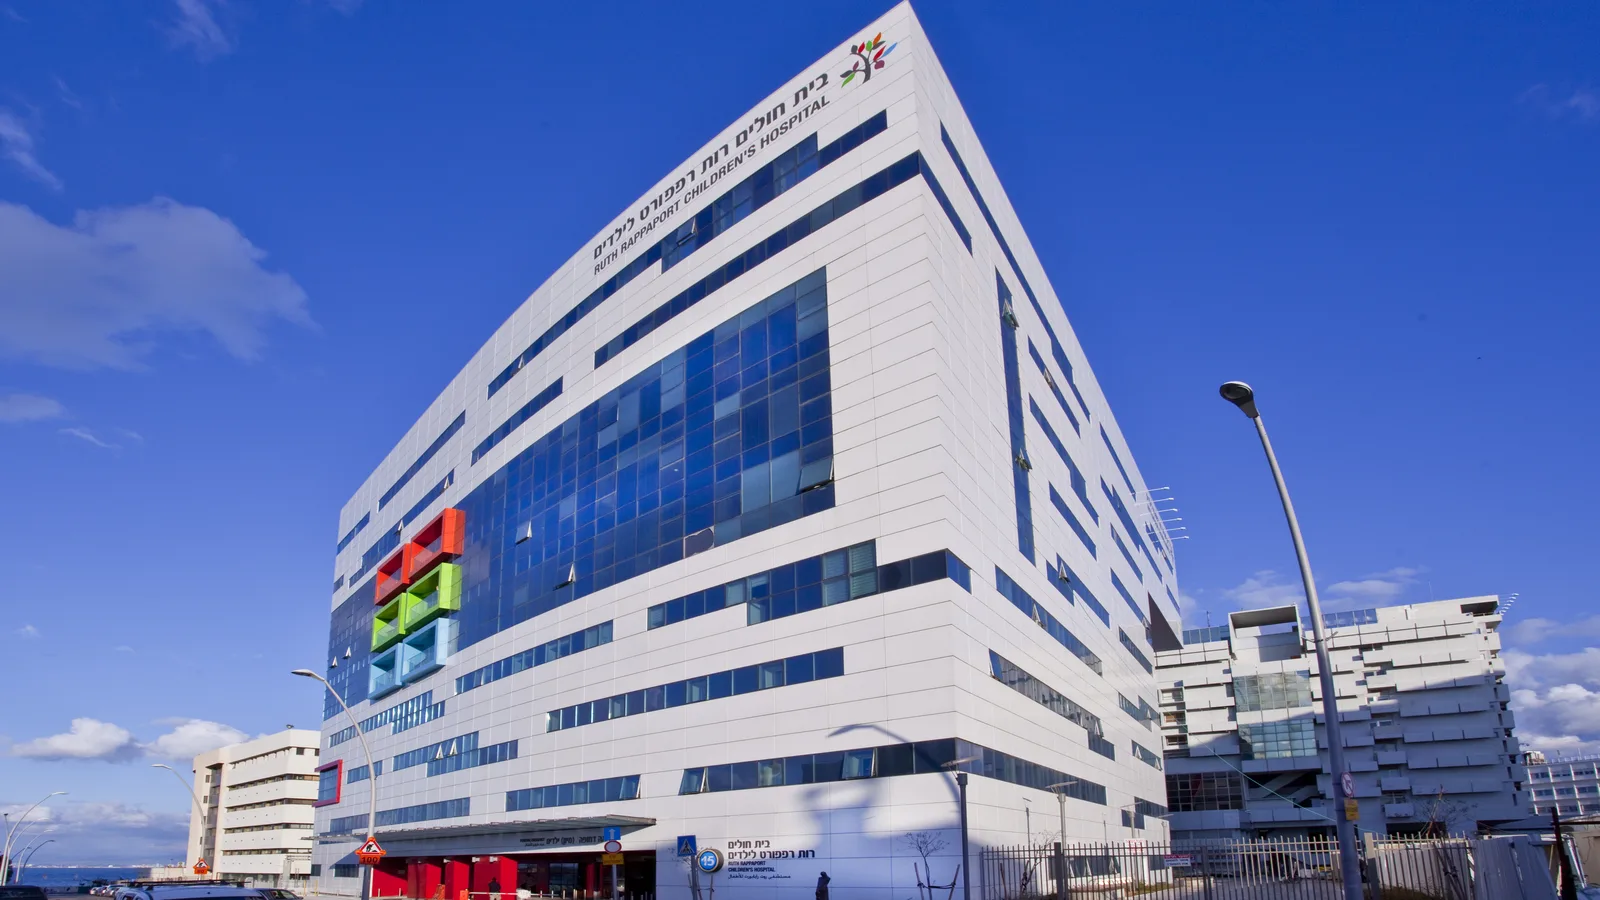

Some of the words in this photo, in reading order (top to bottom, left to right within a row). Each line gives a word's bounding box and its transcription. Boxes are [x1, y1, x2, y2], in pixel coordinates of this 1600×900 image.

[793, 73, 829, 107] בית
[736, 102, 785, 148] חולים
[701, 143, 729, 175] רות
[593, 249, 618, 275] RUTH
[620, 199, 681, 254] RAPPAPORT
[684, 144, 756, 204] CHILDREN'S
[760, 95, 830, 149] HOSPITAL
[639, 169, 695, 221] רפפורט
[593, 216, 635, 260] לילדים
[728, 839, 751, 849] חולים
[754, 840, 771, 848] בית
[728, 849, 756, 859] לילדים
[760, 850, 795, 859] רפפורט
[798, 849, 815, 858] רות
[361, 856, 378, 864] 100
[701, 855, 715, 866] 15
